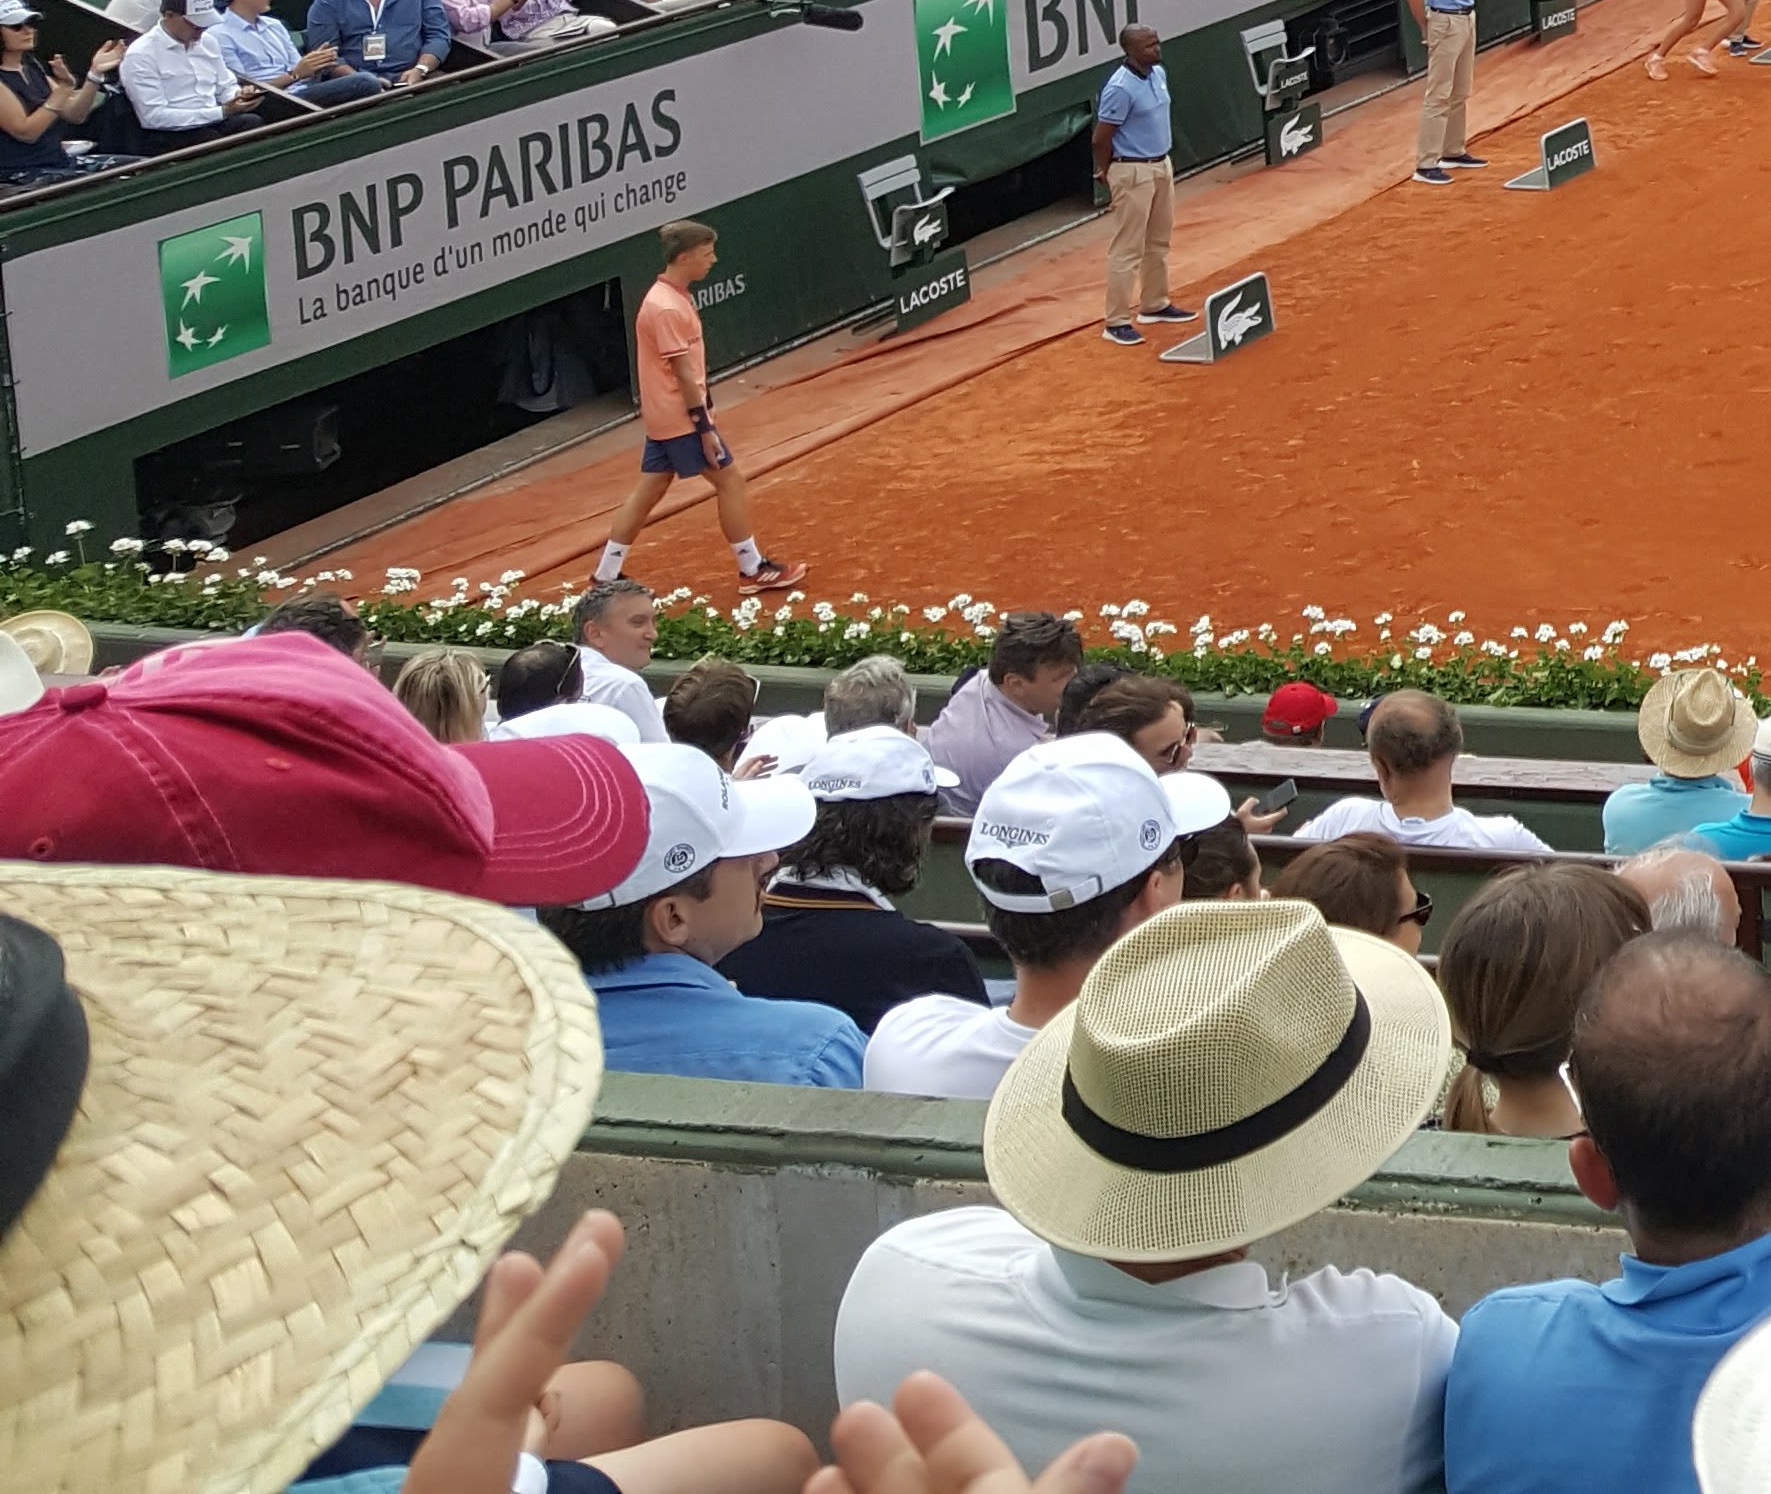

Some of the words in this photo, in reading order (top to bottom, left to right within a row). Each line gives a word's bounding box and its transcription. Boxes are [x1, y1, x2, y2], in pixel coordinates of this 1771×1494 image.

[1542, 8, 1576, 31] LACOSTE
[1547, 139, 1590, 171] LACOSTE
[292, 173, 424, 281] BNP
[443, 89, 682, 229] PARIBAS
[299, 288, 326, 325] La
[335, 261, 425, 312] banque
[433, 241, 483, 278] d'un
[493, 209, 566, 257] monde
[574, 194, 606, 234] qui
[614, 171, 687, 213] change
[900, 269, 966, 314] LACOSTE
[808, 779, 862, 790] LONGINES
[980, 823, 1051, 846] LONGINES
